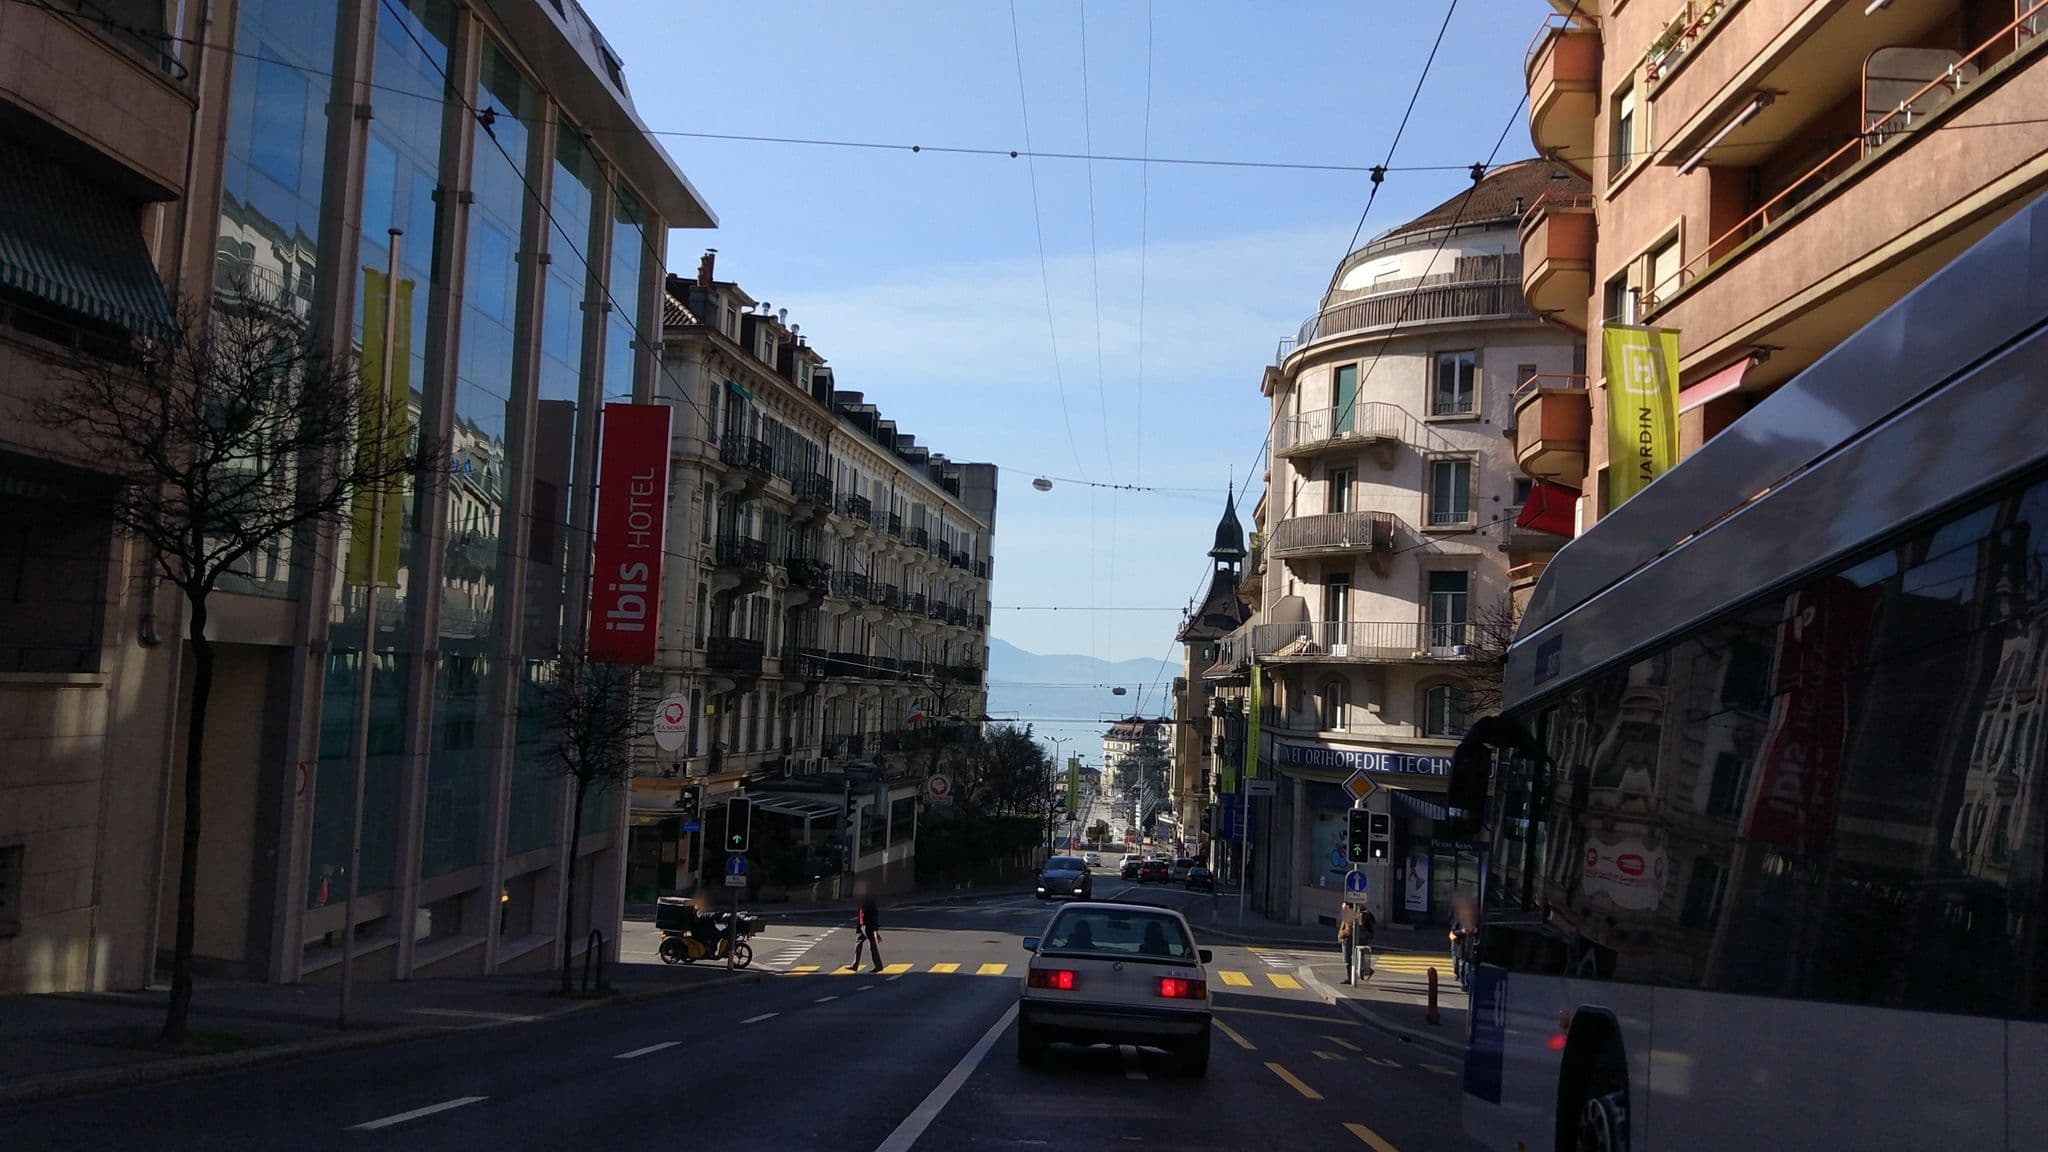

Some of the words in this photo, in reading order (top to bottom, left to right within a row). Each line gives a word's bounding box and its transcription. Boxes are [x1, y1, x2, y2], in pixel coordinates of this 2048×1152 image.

[1639, 407, 1653, 487] JARDIN
[605, 561, 649, 632] ibis
[627, 467, 655, 549] HOTEL
[1305, 750, 1390, 772] ORTHOPEDIE
